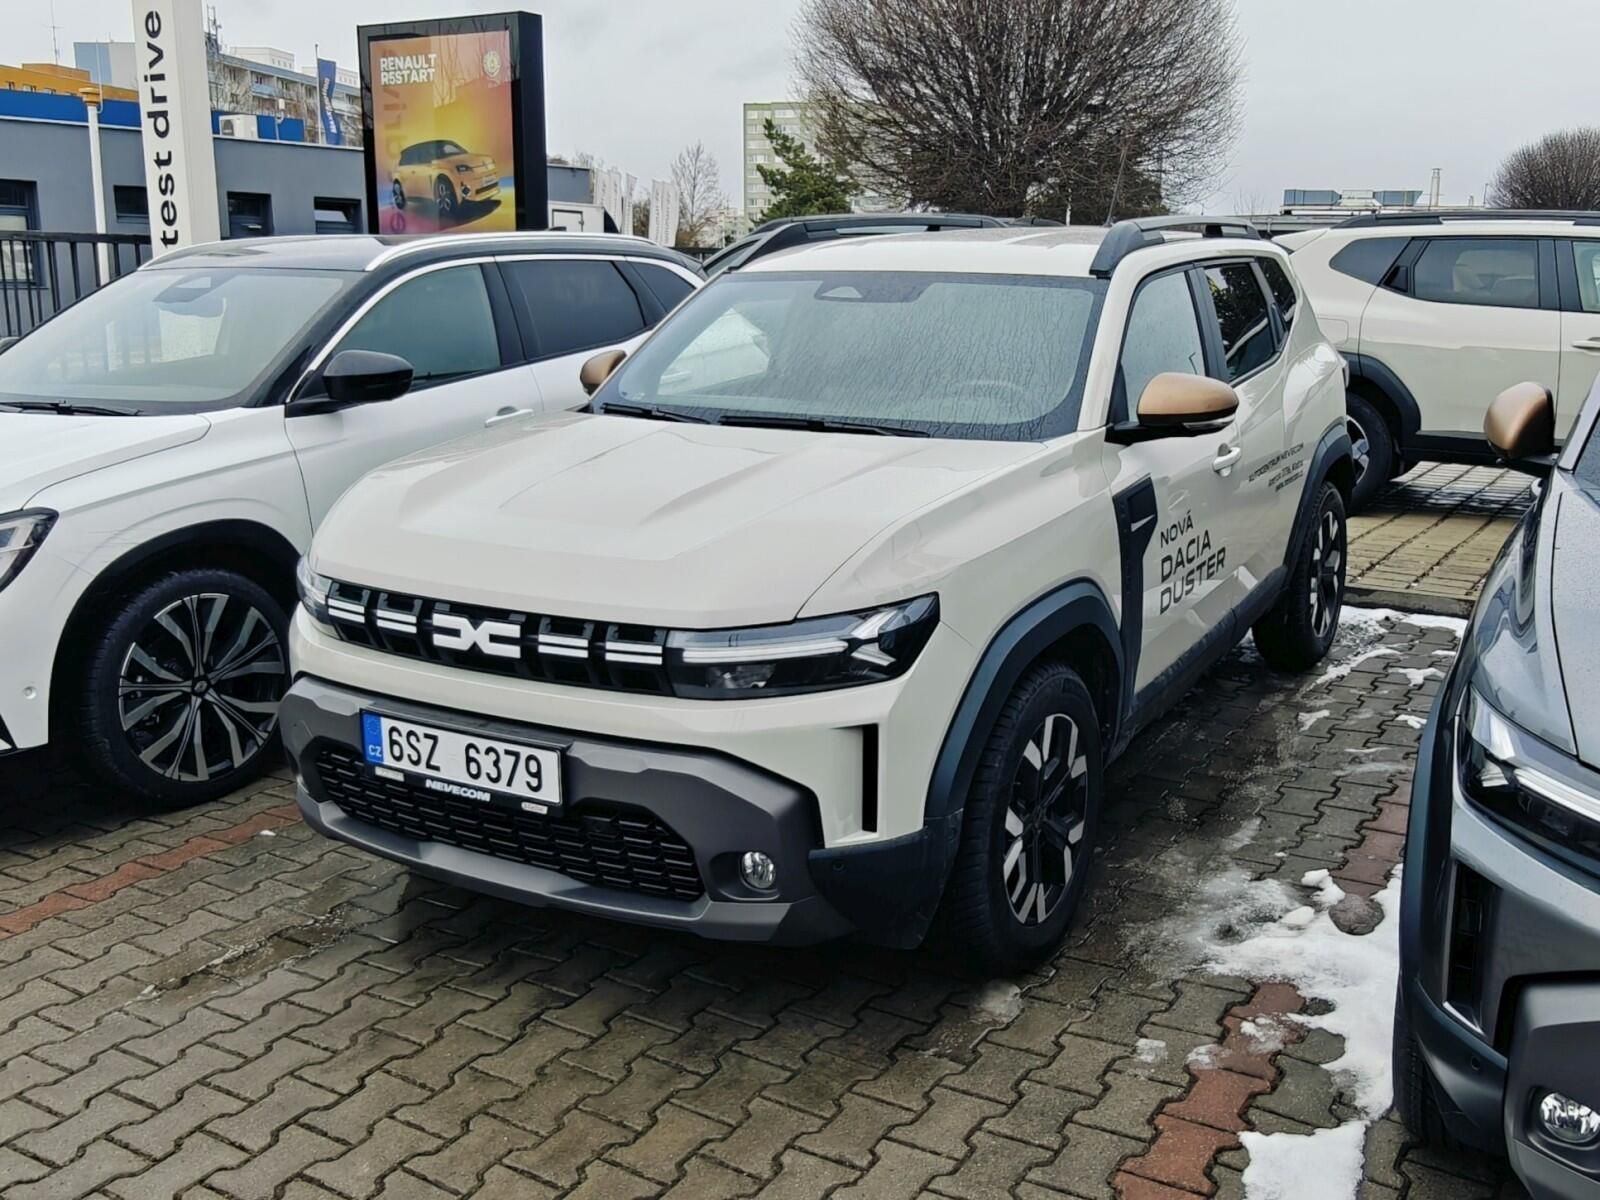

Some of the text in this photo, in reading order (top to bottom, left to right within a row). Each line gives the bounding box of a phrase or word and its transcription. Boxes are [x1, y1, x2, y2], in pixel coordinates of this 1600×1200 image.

[380, 53, 437, 72] RENAULT
[144, 10, 179, 249] test drive
[1160, 509, 1194, 549] NOVÁ
[1160, 529, 1212, 584] DACIA
[1159, 546, 1226, 616] DUSTER
[368, 744, 383, 758] CZ
[388, 725, 543, 793] 6SZ 6379
[425, 778, 491, 802] NEVECOM
